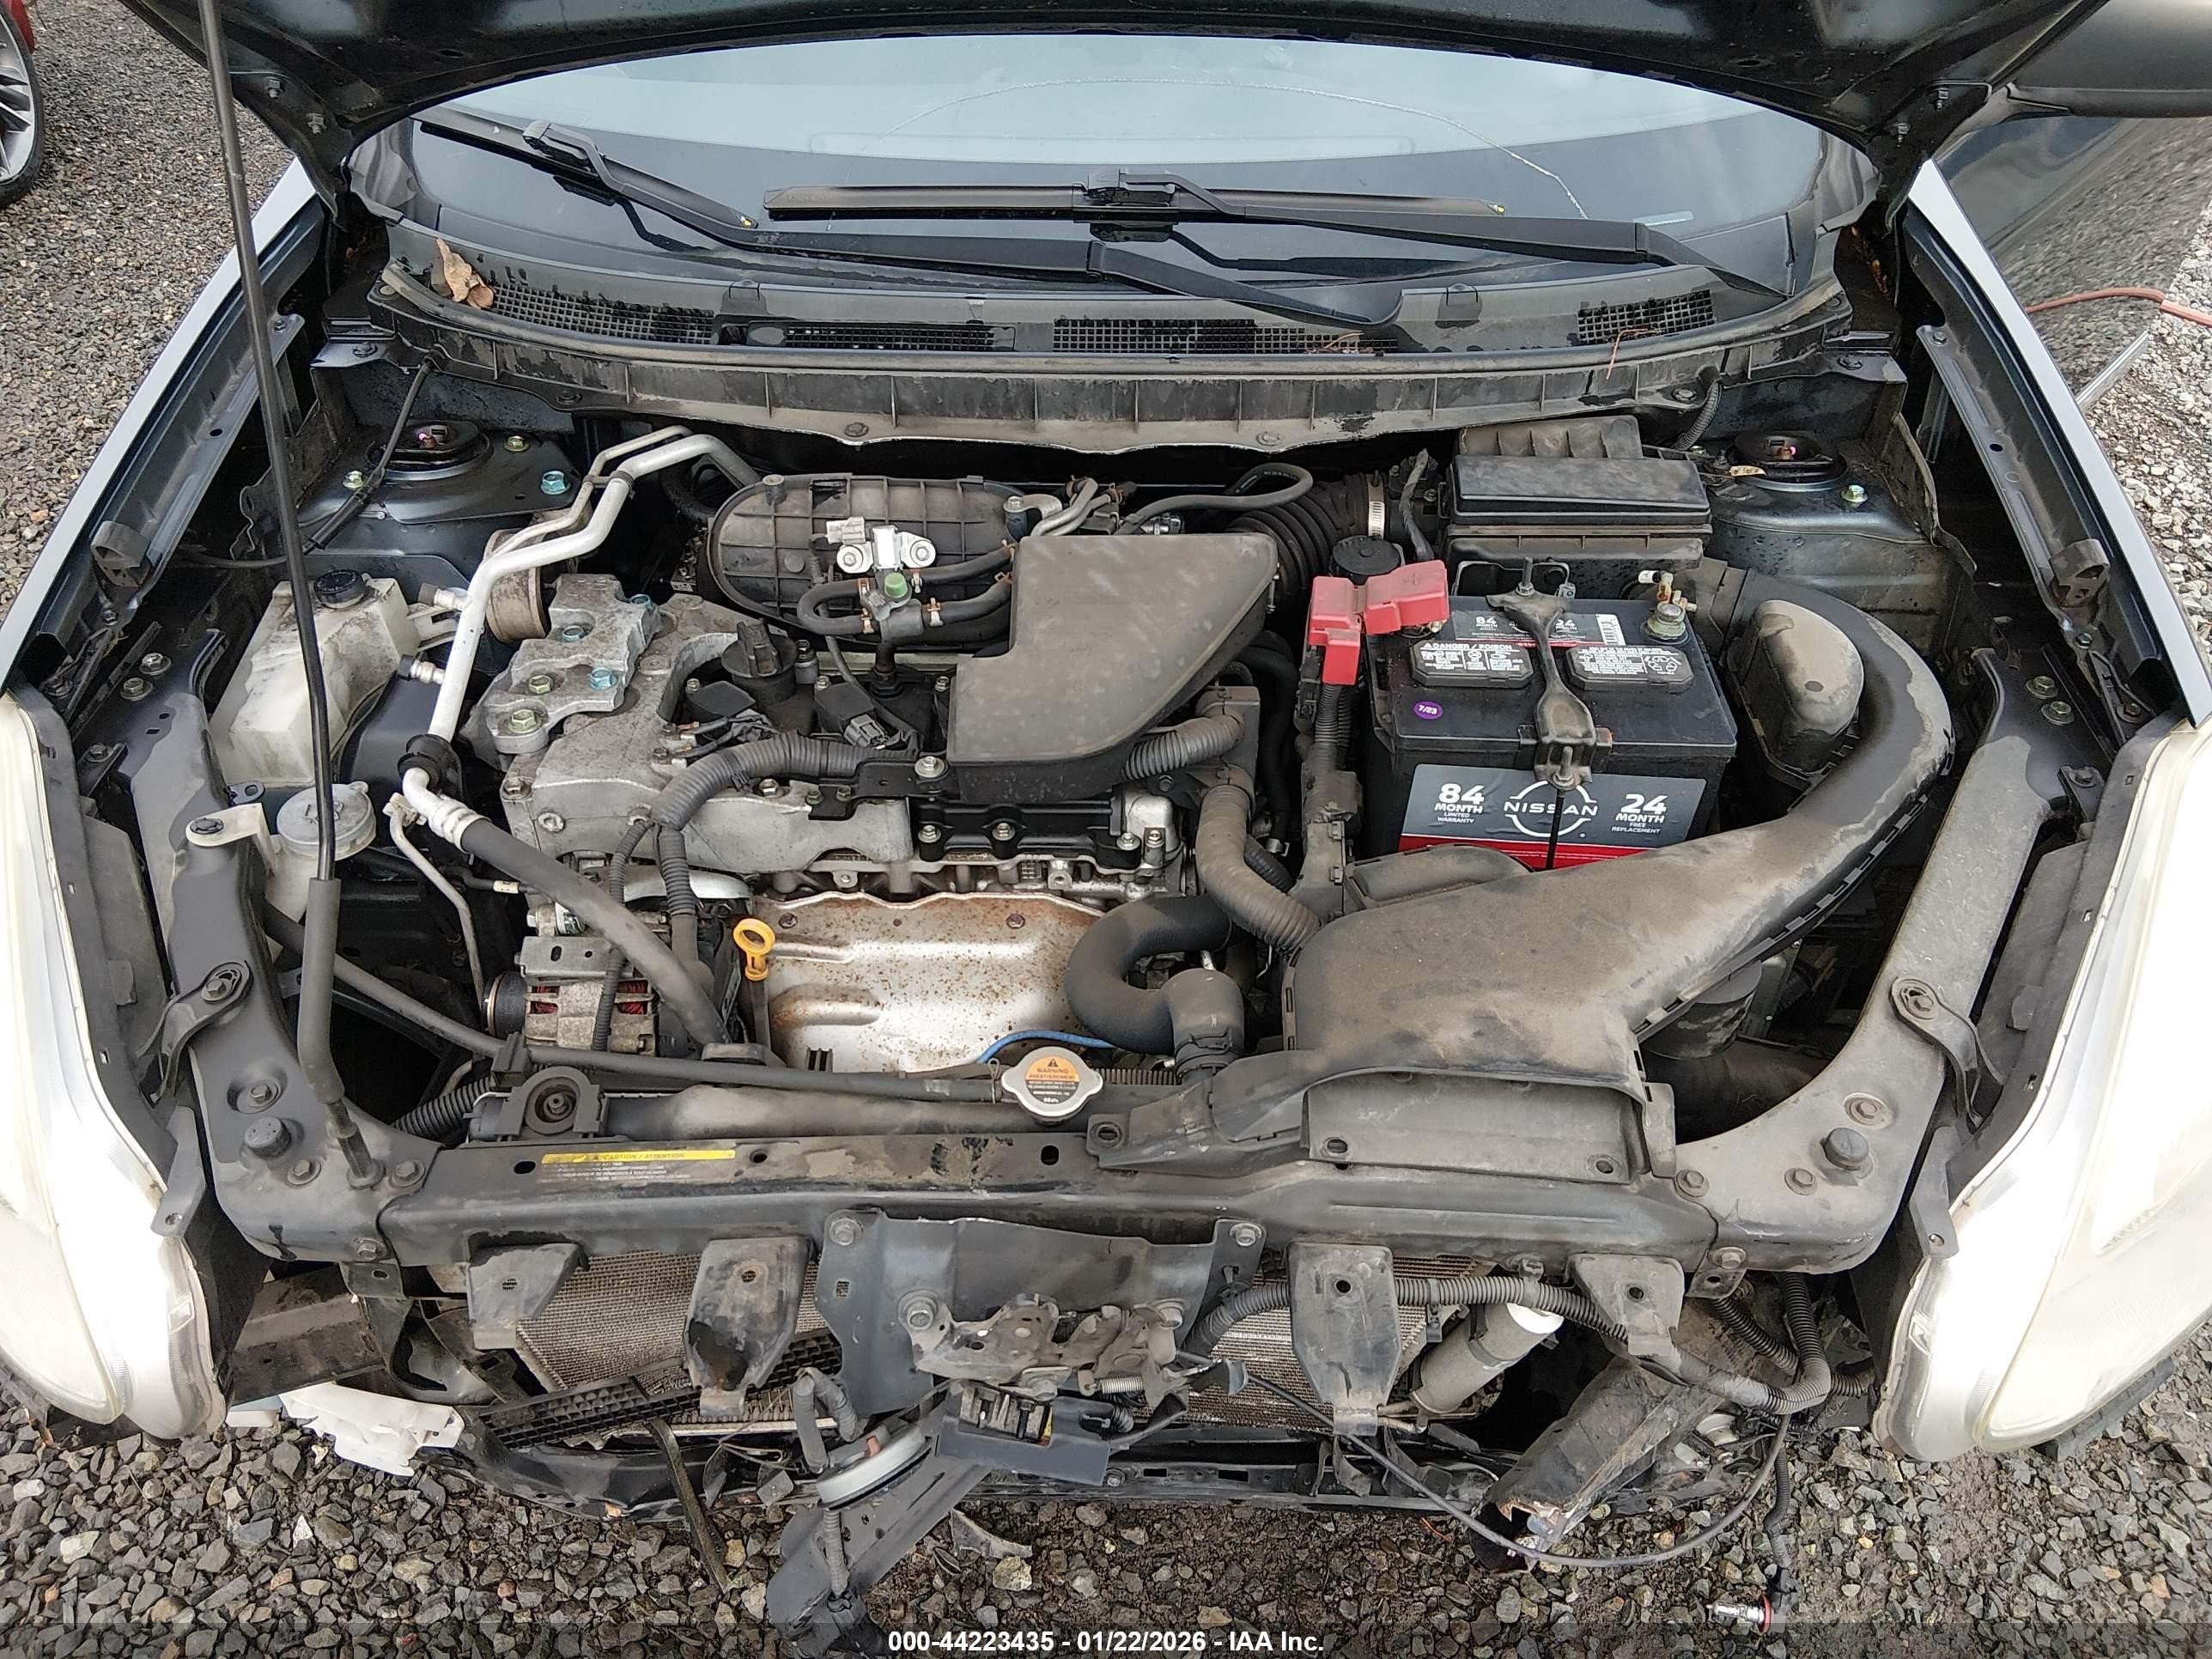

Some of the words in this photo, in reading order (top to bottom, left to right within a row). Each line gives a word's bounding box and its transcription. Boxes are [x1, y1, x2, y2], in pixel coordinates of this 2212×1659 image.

[1475, 616, 1498, 624] 84
[1438, 783, 1485, 805] 84
[1434, 802, 1483, 814] MONTH
[1504, 801, 1598, 816] NISSAN
[1620, 793, 1668, 815] 24
[1615, 812, 1665, 823] MONTH
